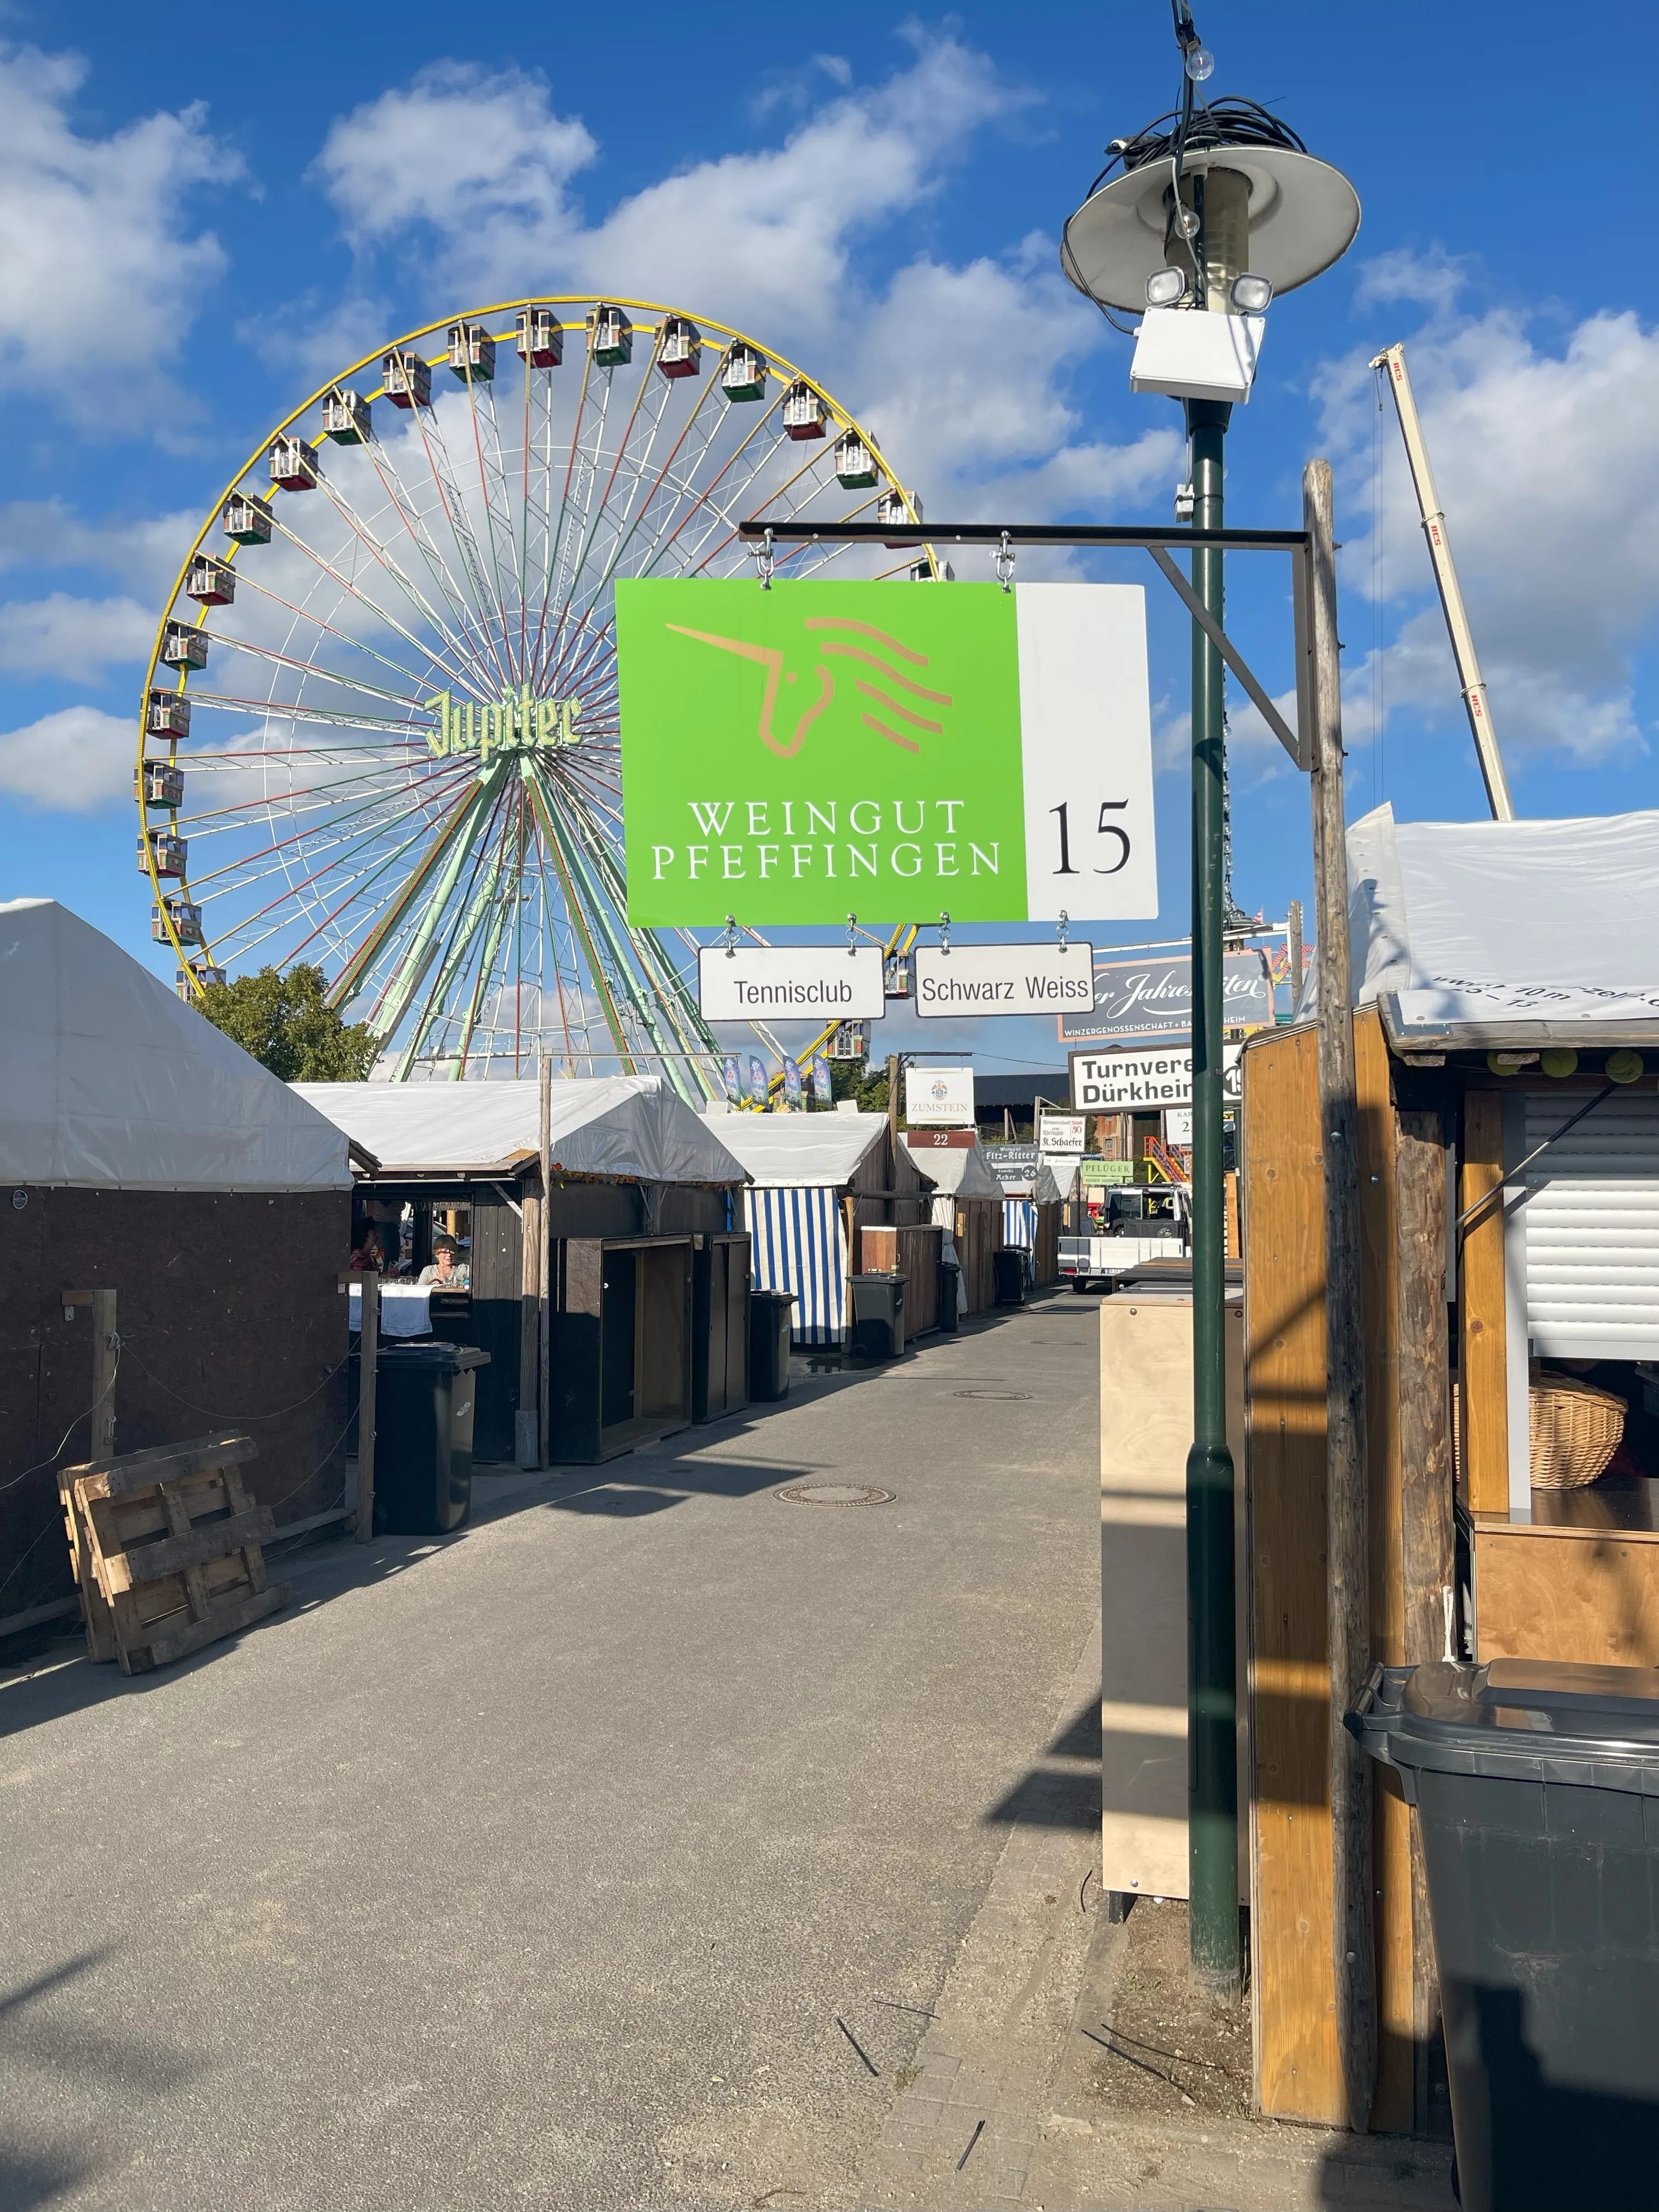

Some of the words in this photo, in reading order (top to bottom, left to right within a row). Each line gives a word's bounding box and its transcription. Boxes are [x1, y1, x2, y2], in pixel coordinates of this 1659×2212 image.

[424, 682, 583, 765] Jupiter
[687, 800, 964, 838] WEINGUT
[1049, 799, 1131, 874] 15
[651, 843, 1000, 881] PFEFFINGEN
[733, 980, 853, 1004] Tennisclub
[922, 978, 1015, 1001] Schwarz
[1025, 976, 1089, 998] Weiss
[1106, 970, 1266, 1019] Jahresiten
[1064, 1022, 1173, 1037] WINZERGENOSSENSCHAFT
[1181, 1020, 1192, 1029] BA
[1082, 1058, 1192, 1079] Turnvere
[912, 1103, 968, 1112] ZUMSTEIN
[1071, 1126, 1082, 1134] 30
[1182, 1121, 1192, 1132] 2
[933, 1133, 948, 1146] 22
[1051, 1137, 1082, 1148] Schaefer
[986, 1152, 1036, 1160] Fitz-Ritter
[1086, 1164, 1130, 1173] PFLÜGER
